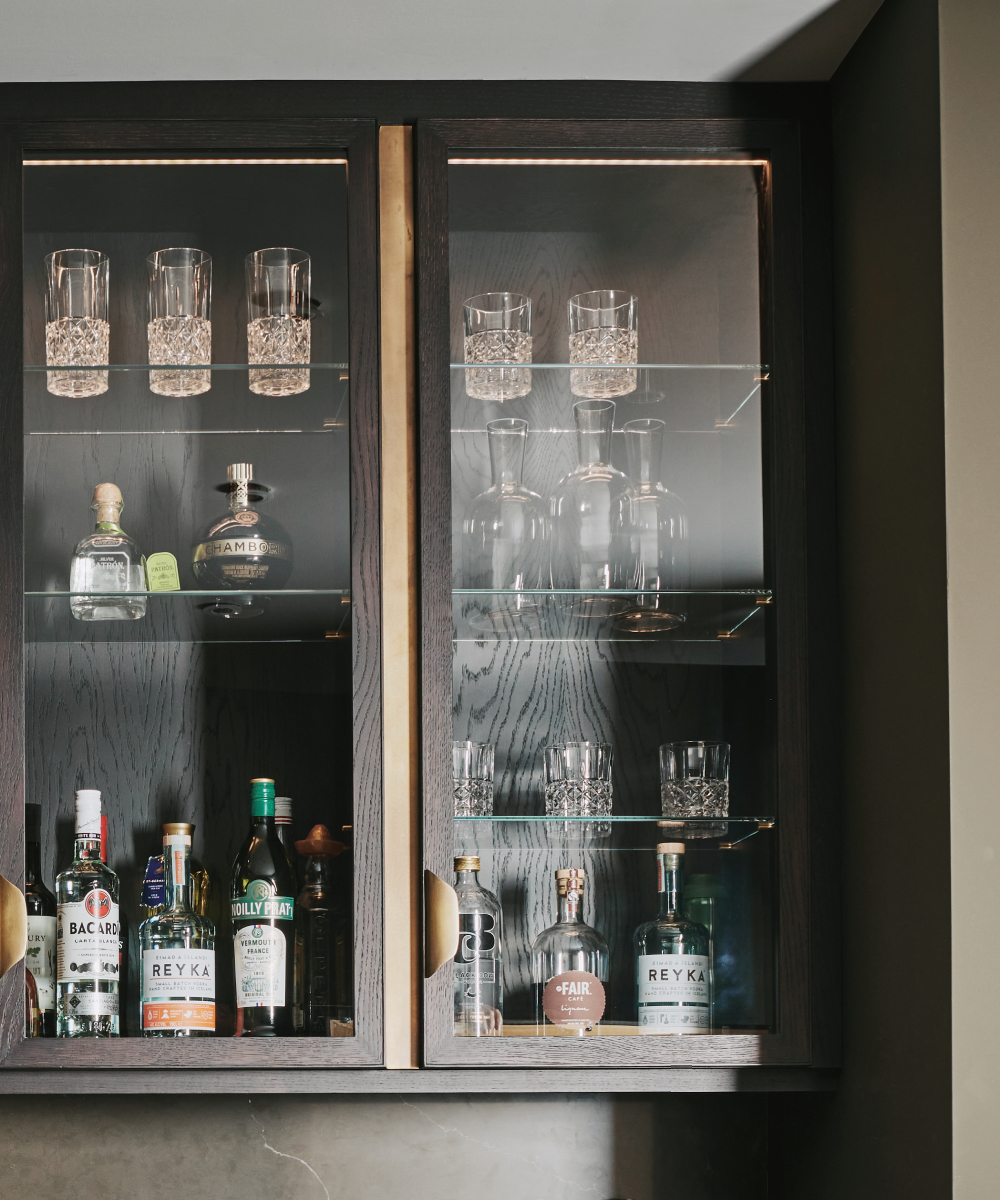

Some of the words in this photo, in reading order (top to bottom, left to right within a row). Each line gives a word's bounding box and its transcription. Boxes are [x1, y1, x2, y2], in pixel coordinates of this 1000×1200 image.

[232, 902, 261, 916] NOILLY
[264, 901, 290, 915] PRAT
[152, 963, 210, 977] REYKA
[648, 969, 705, 982] REYKA
